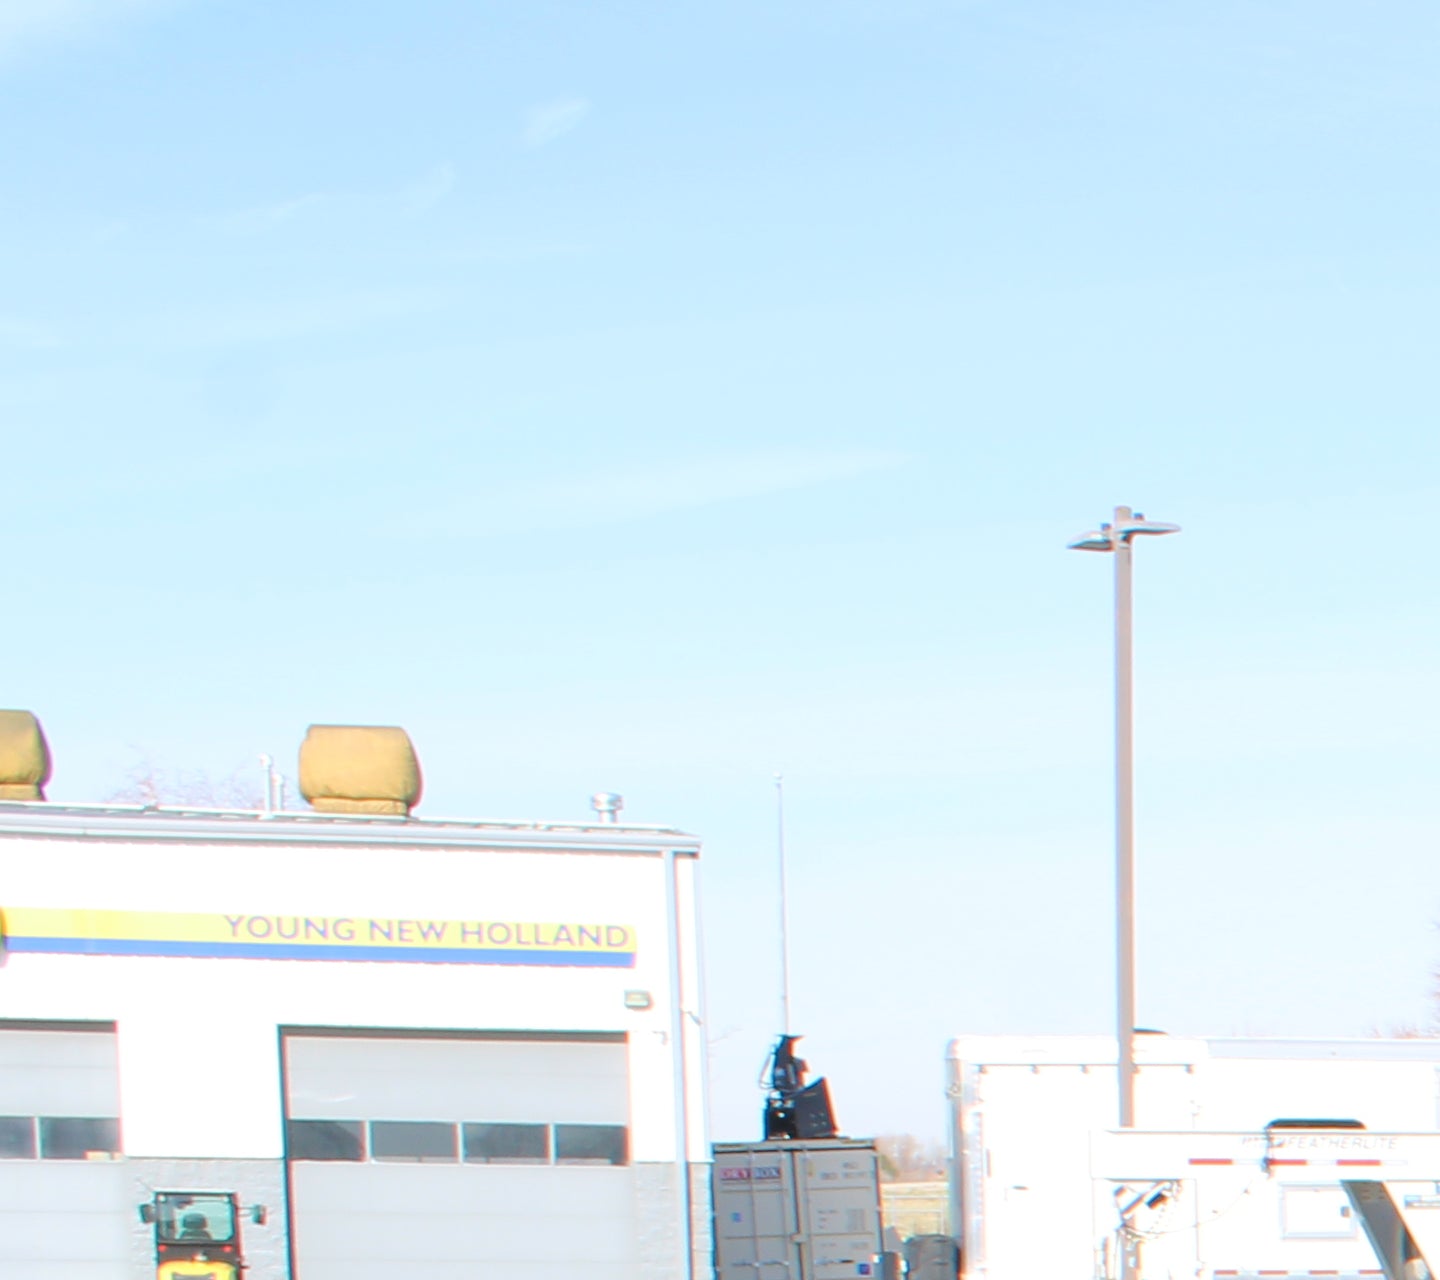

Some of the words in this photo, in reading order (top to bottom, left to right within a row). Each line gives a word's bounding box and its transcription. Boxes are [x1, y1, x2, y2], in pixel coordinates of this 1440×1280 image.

[223, 914, 356, 941] YOUNG
[369, 919, 448, 942] NEW
[461, 921, 630, 947] HOLLAND
